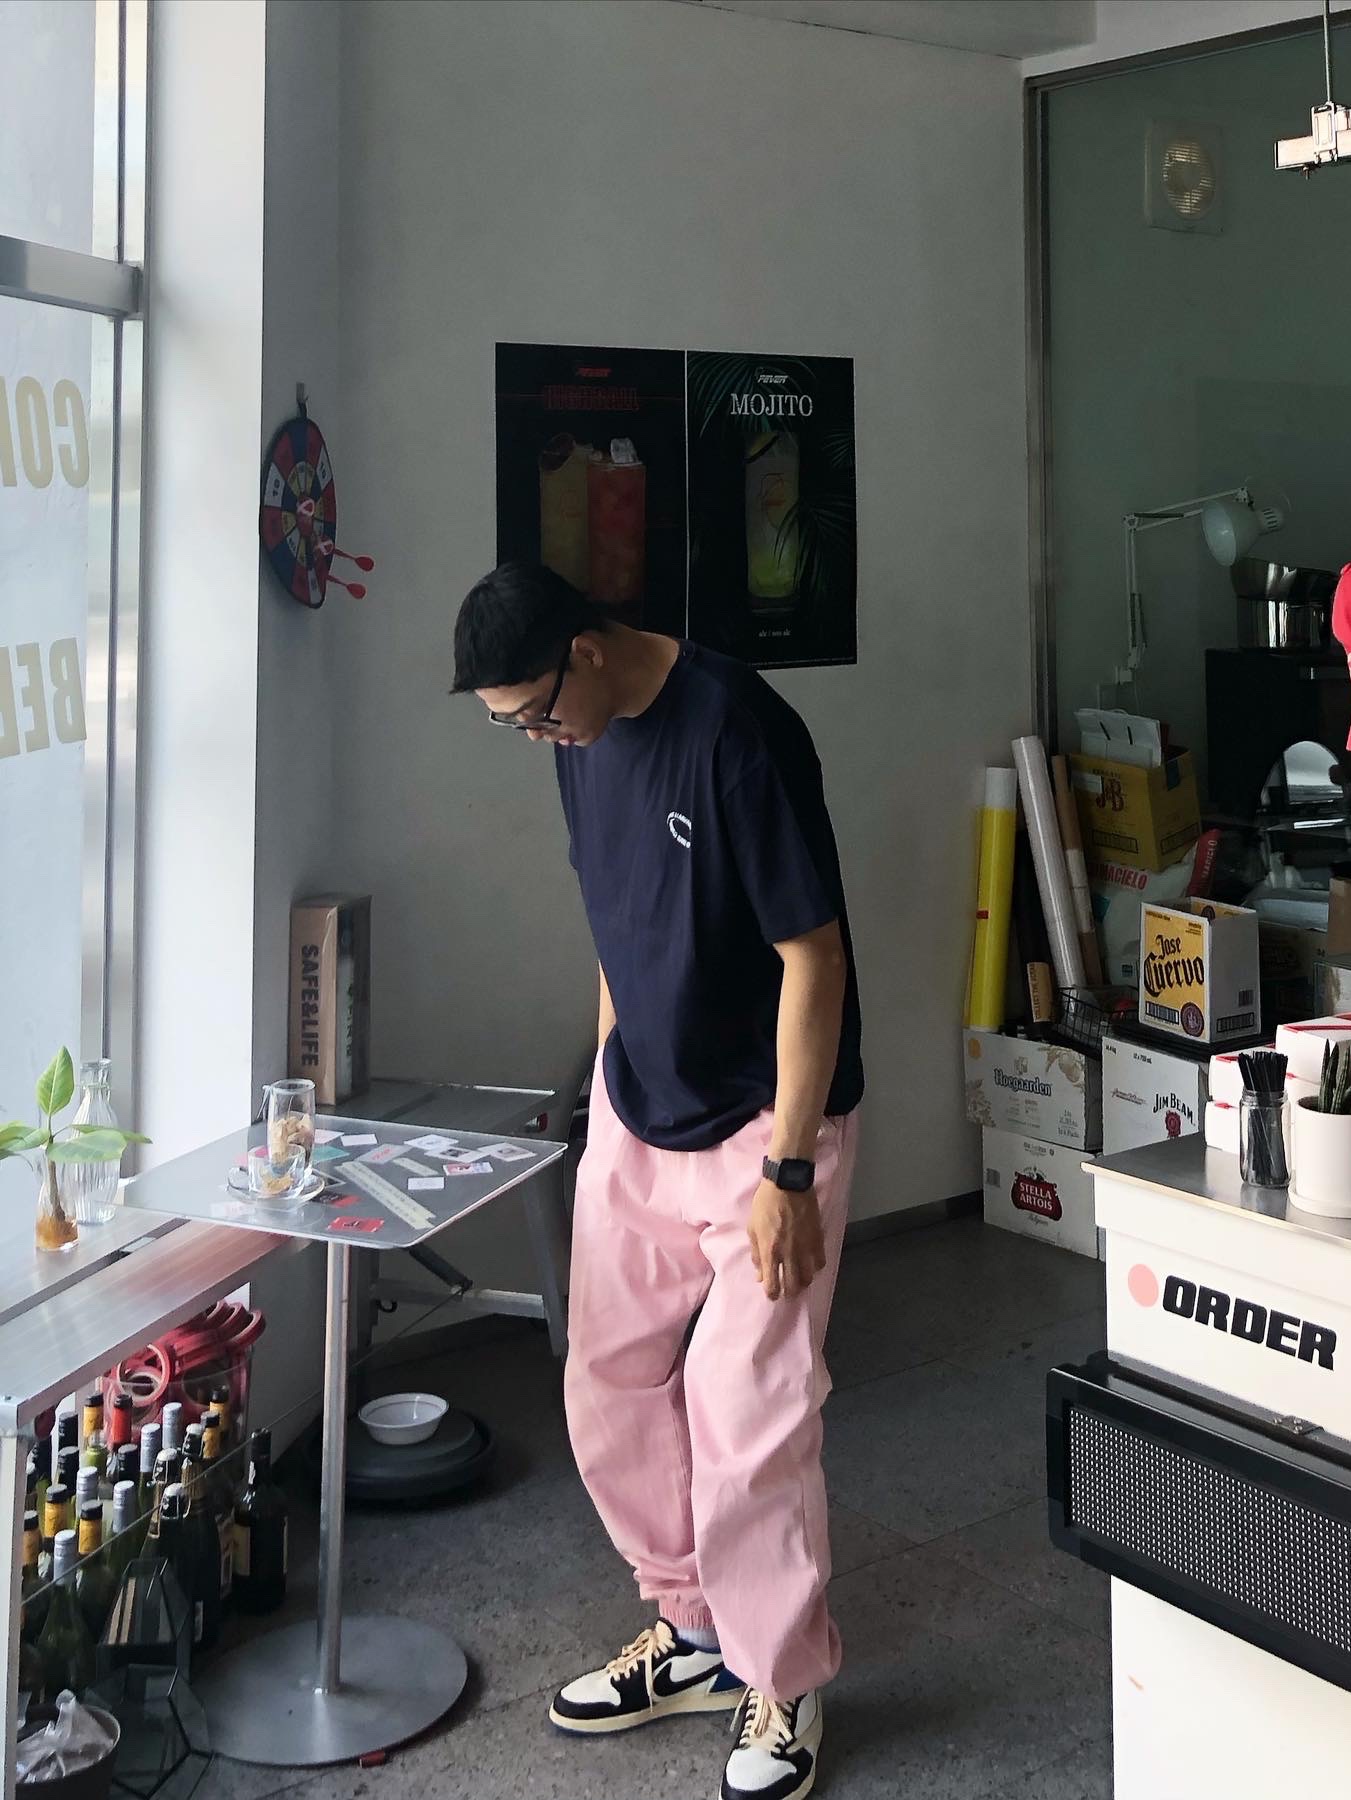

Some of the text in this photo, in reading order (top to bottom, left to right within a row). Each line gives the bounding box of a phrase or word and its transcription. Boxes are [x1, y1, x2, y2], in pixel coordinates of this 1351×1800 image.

[730, 393, 813, 417] MOJITO
[1155, 934, 1181, 959] Jose
[1144, 952, 1205, 997] Cuervo
[302, 944, 319, 1066] SAFE&LIFE
[994, 1068, 1053, 1096] Hoegaarden
[1153, 1093, 1168, 1113] JIM
[1170, 1092, 1193, 1124] BEAM
[1019, 1182, 1052, 1200] STELLA
[1019, 1193, 1053, 1211] ARTOIS
[1163, 1275, 1337, 1371] ORDER
